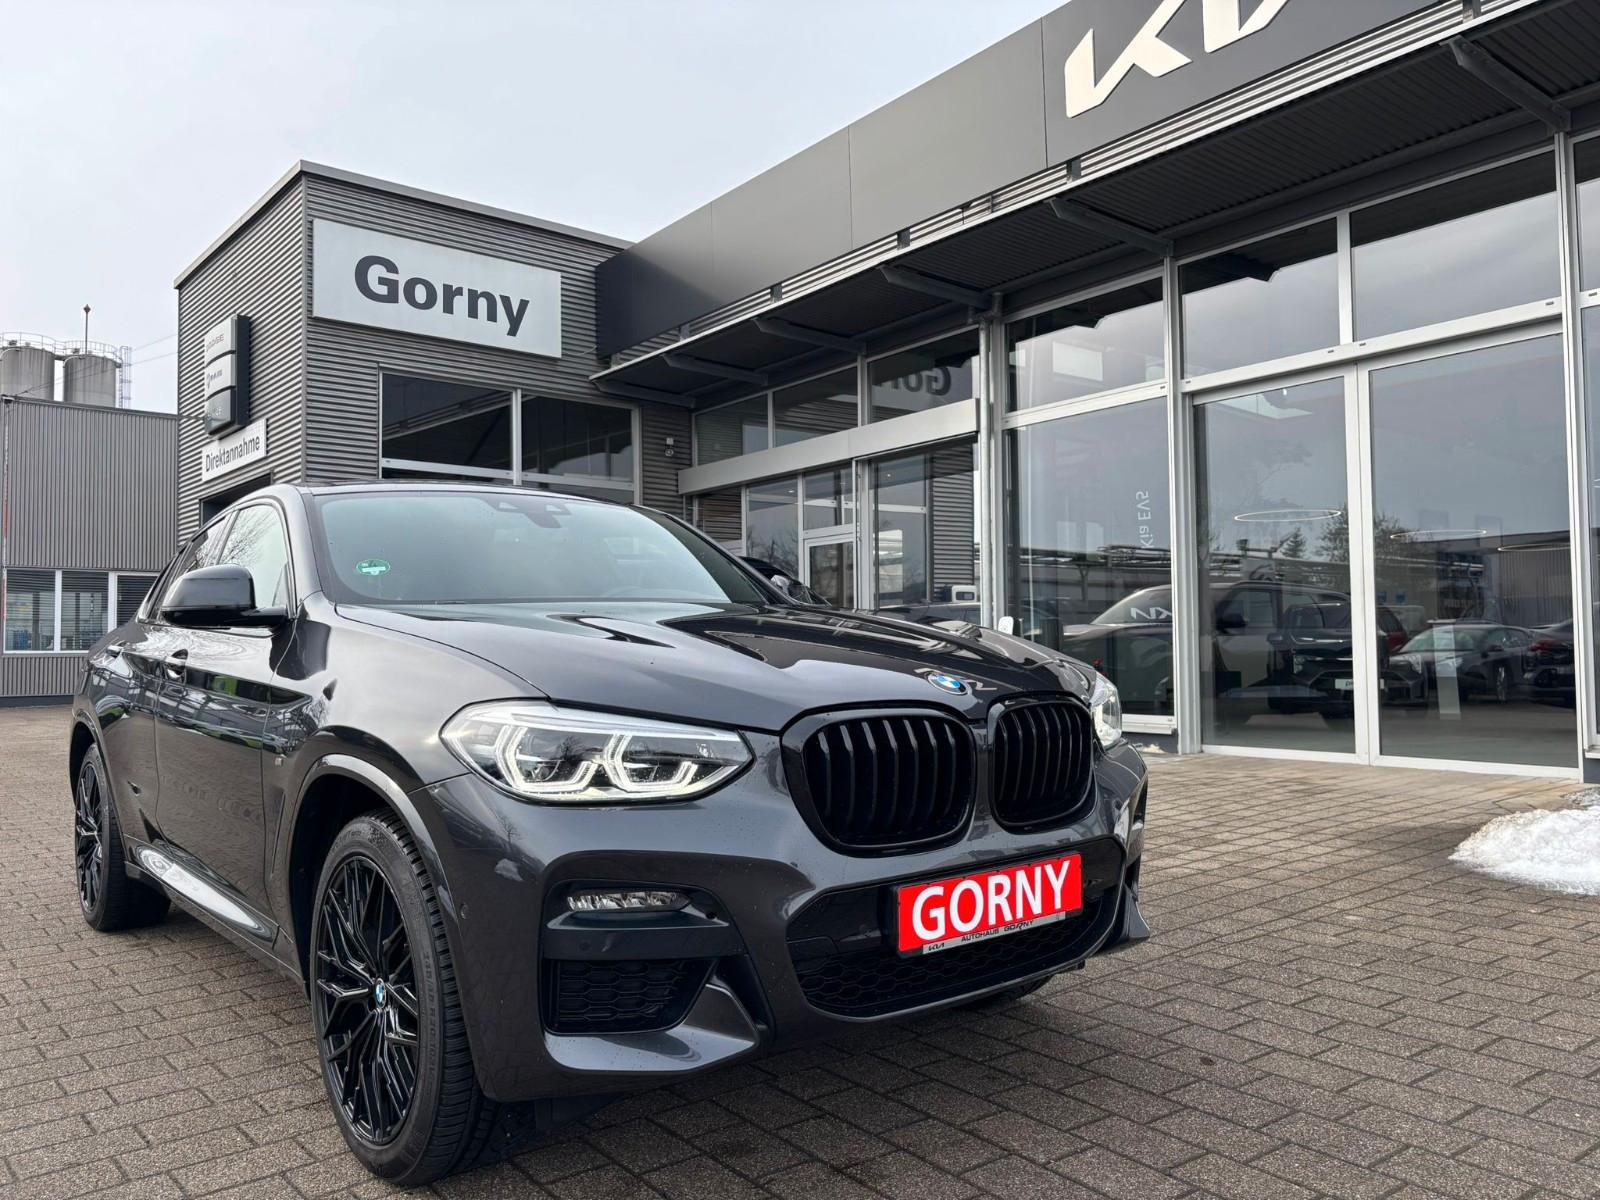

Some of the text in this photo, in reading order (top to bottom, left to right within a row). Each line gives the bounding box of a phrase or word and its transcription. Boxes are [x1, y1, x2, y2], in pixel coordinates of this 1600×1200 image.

[354, 255, 530, 337] Gorny
[205, 436, 260, 472] Direktannahme
[912, 860, 1071, 941] GORNY
[961, 929, 1000, 942] AUTOHAUS
[1004, 920, 1034, 932] GORNY
